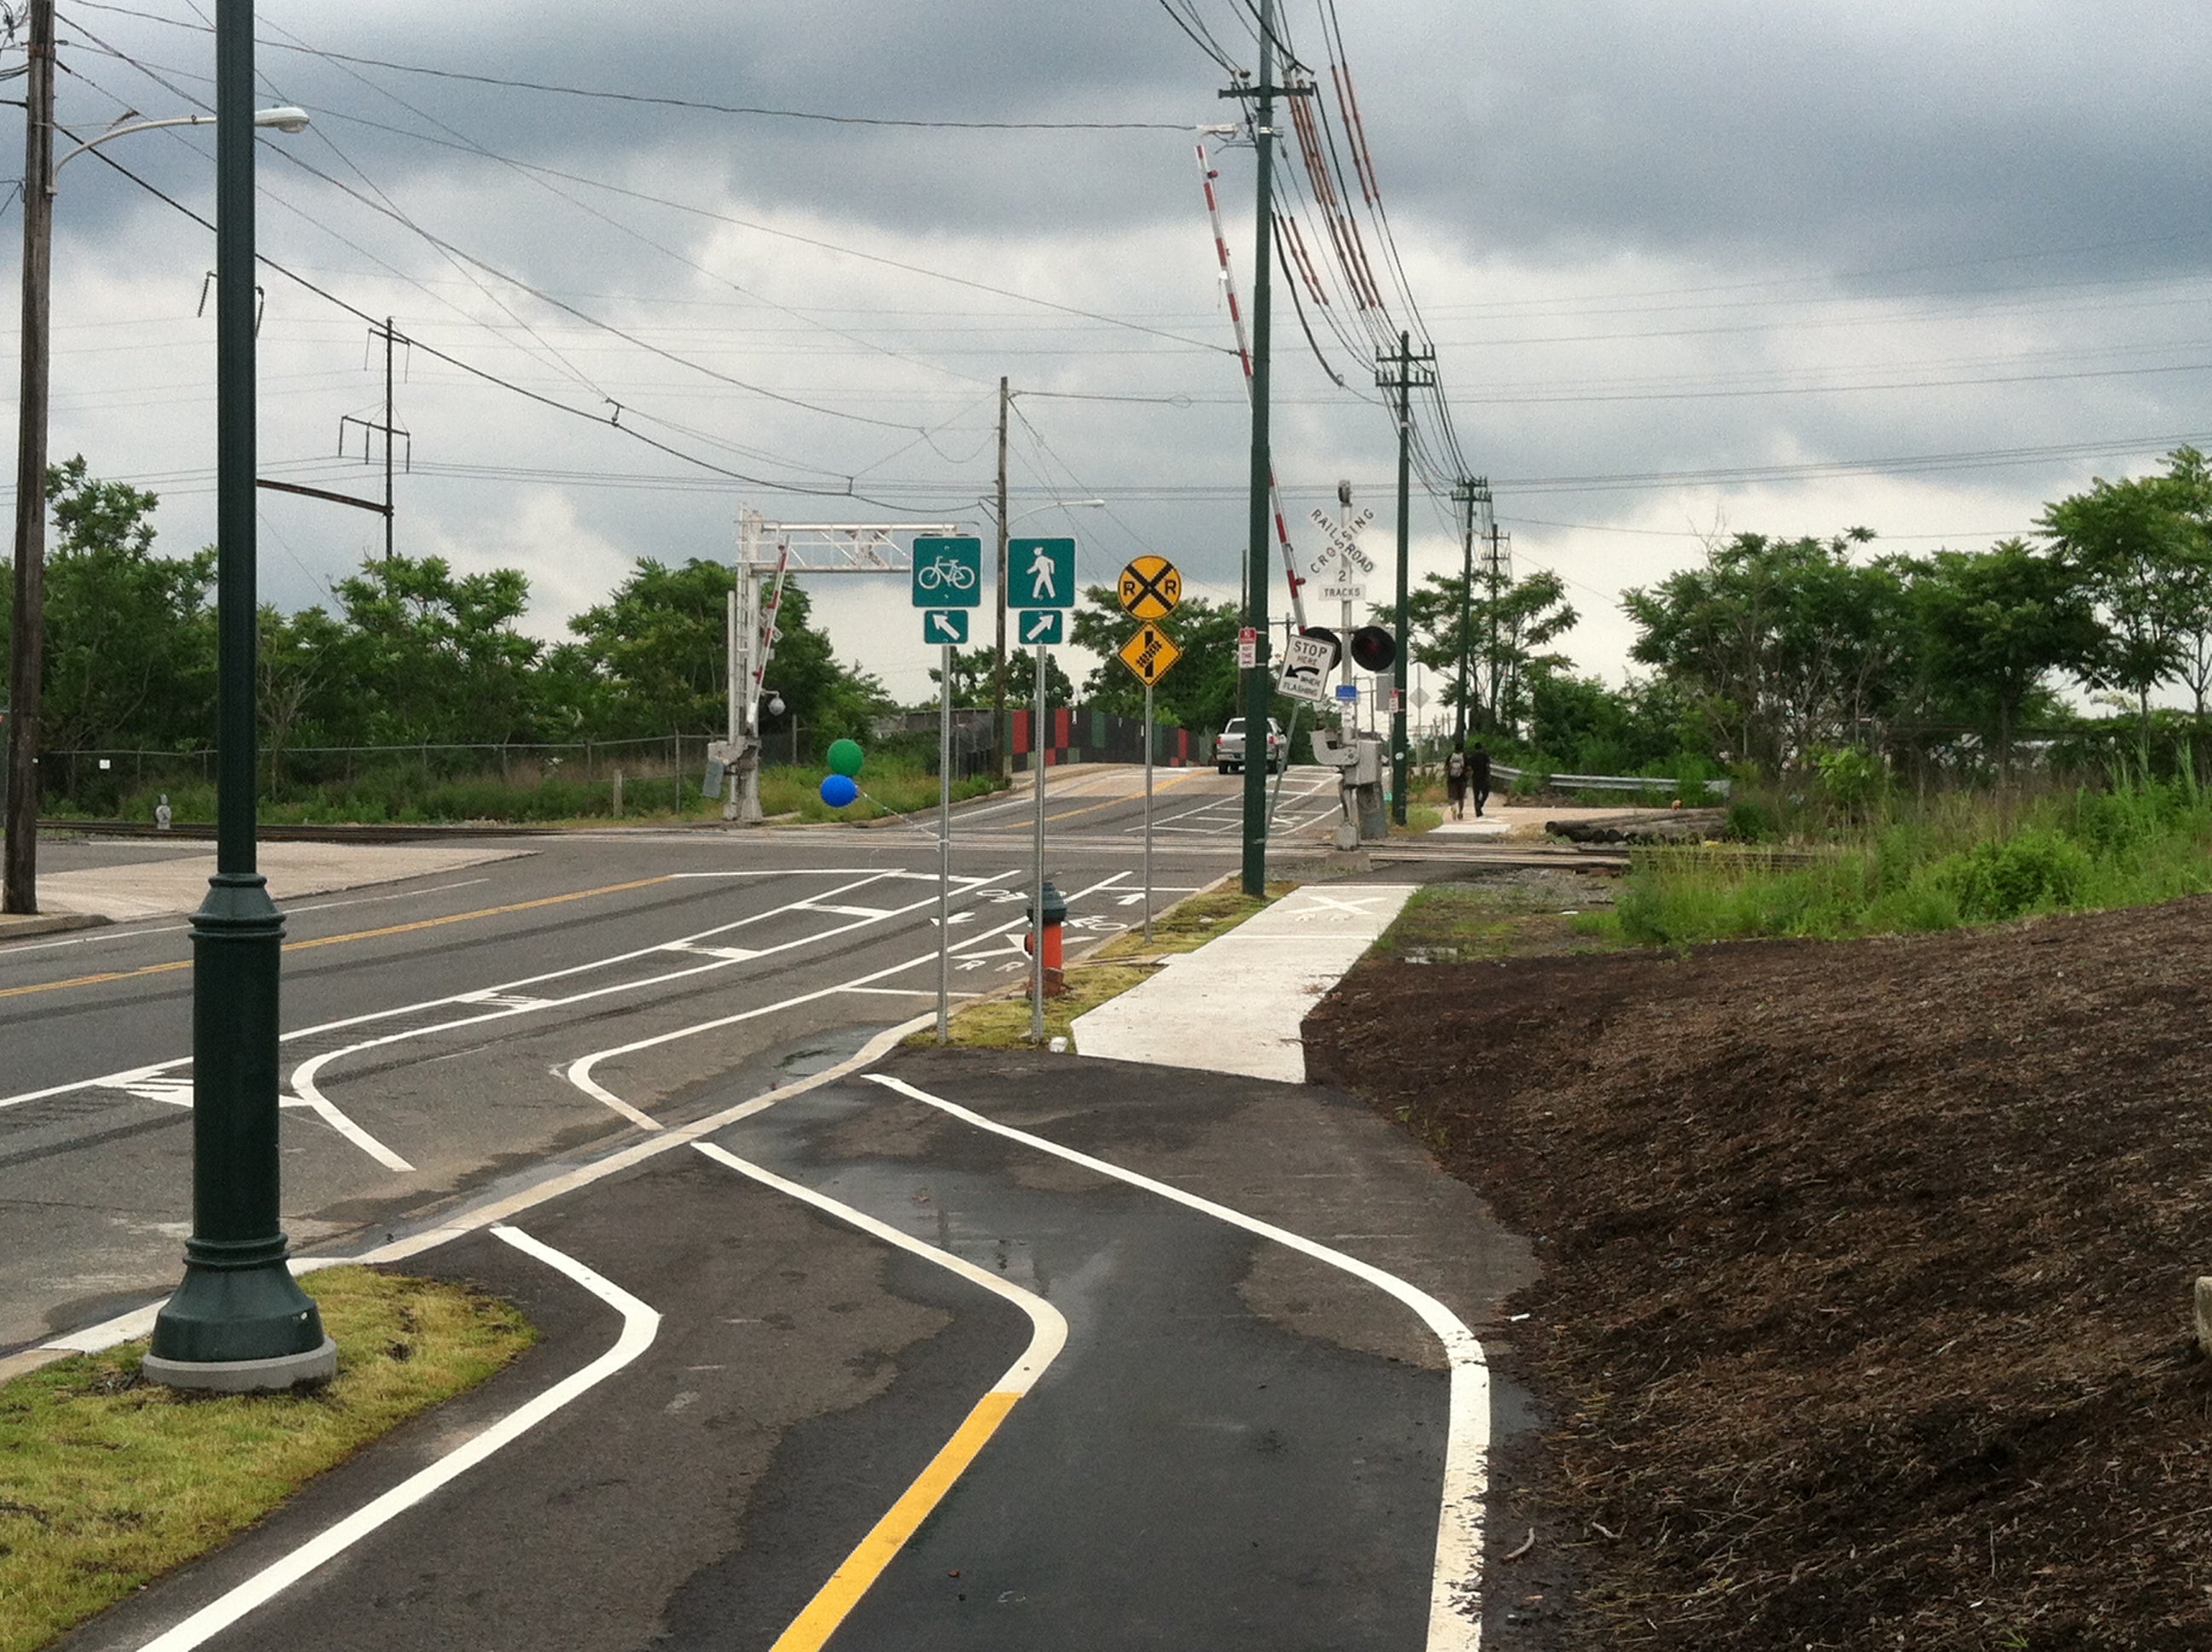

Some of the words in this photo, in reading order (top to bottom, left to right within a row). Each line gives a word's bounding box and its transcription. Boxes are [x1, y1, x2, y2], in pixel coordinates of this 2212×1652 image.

[1310, 508, 1374, 573] RAILROAD
[1310, 508, 1374, 573] CROSSING
[1338, 570, 1347, 582] 2
[1123, 580, 1135, 596] R
[1164, 579, 1177, 596] R
[1324, 587, 1361, 597] TRACKS
[1293, 640, 1328, 658] STOP
[1296, 655, 1318, 666] HERE
[1284, 682, 1318, 696] FLASHING
